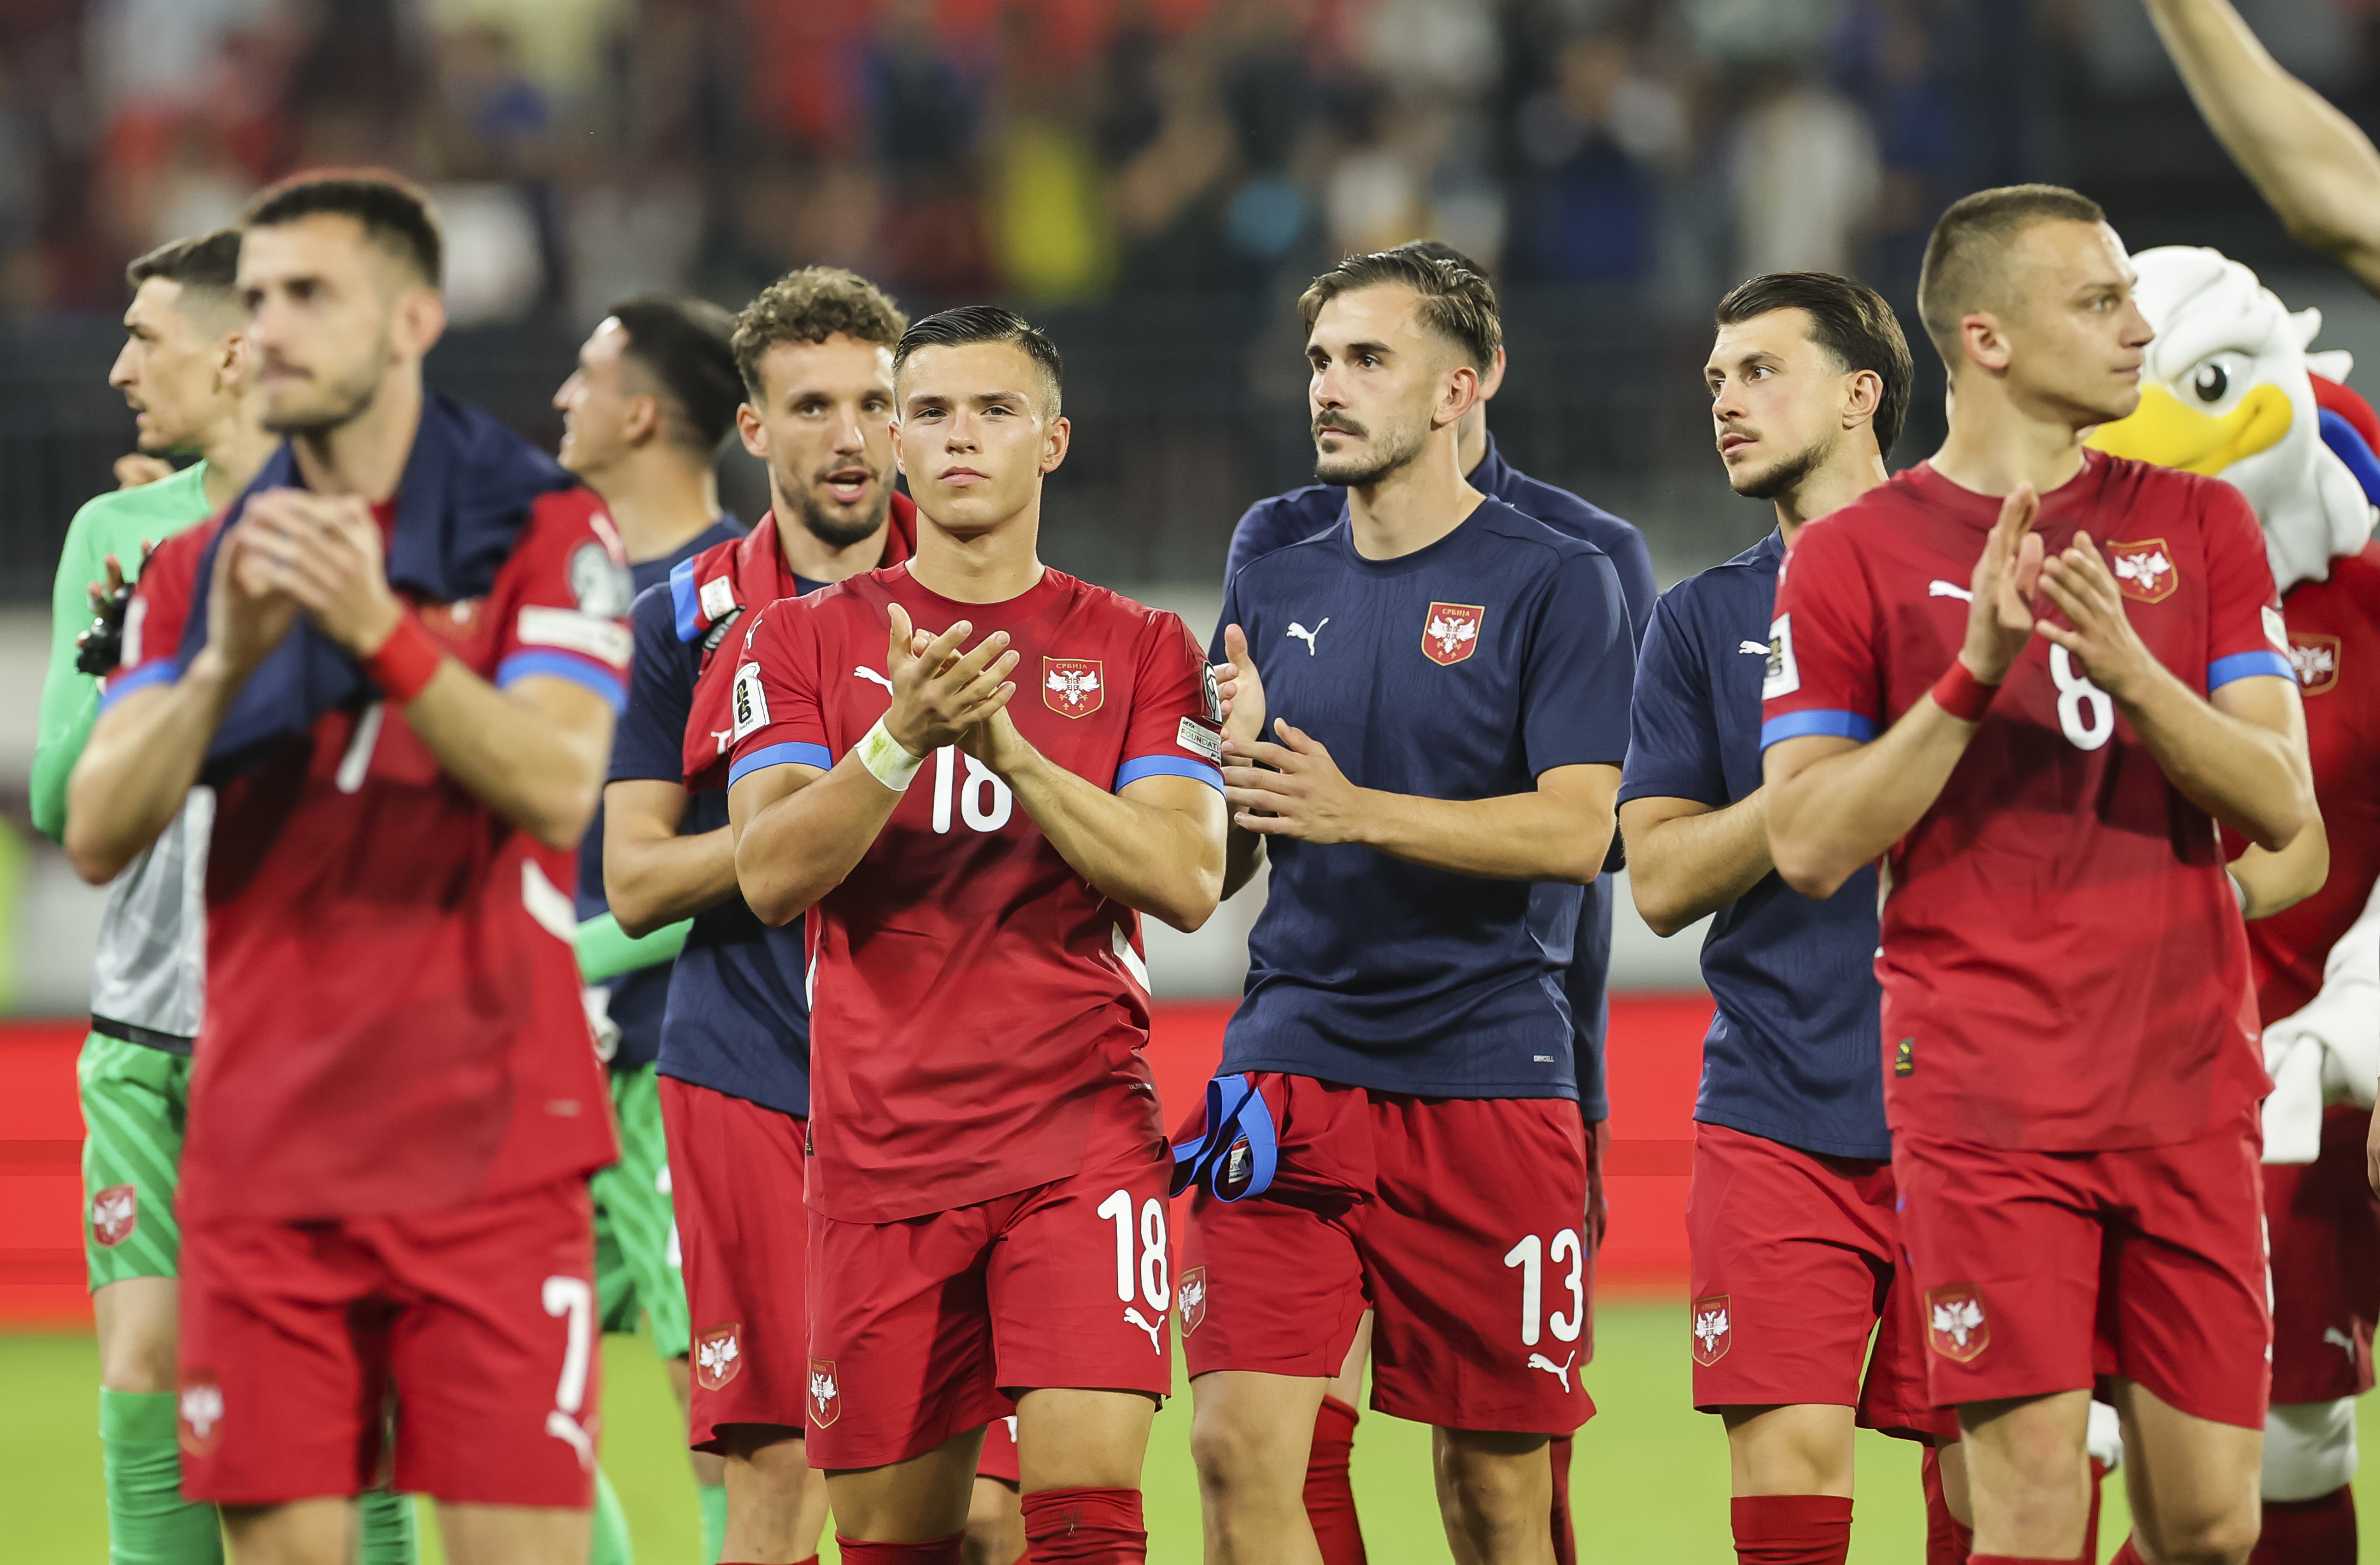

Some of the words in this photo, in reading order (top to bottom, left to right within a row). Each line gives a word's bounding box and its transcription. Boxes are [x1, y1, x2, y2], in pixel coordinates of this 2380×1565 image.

[1442, 608, 1470, 617] СРБИЈА
[1181, 728, 1221, 752] FOUNDATI
[1183, 719, 1195, 729] UEFA
[2048, 641, 2115, 751] 8
[932, 744, 1015, 834] 18
[1097, 1189, 1171, 1311] 18
[1504, 1228, 1583, 1346] 13
[541, 1274, 593, 1414] 7
